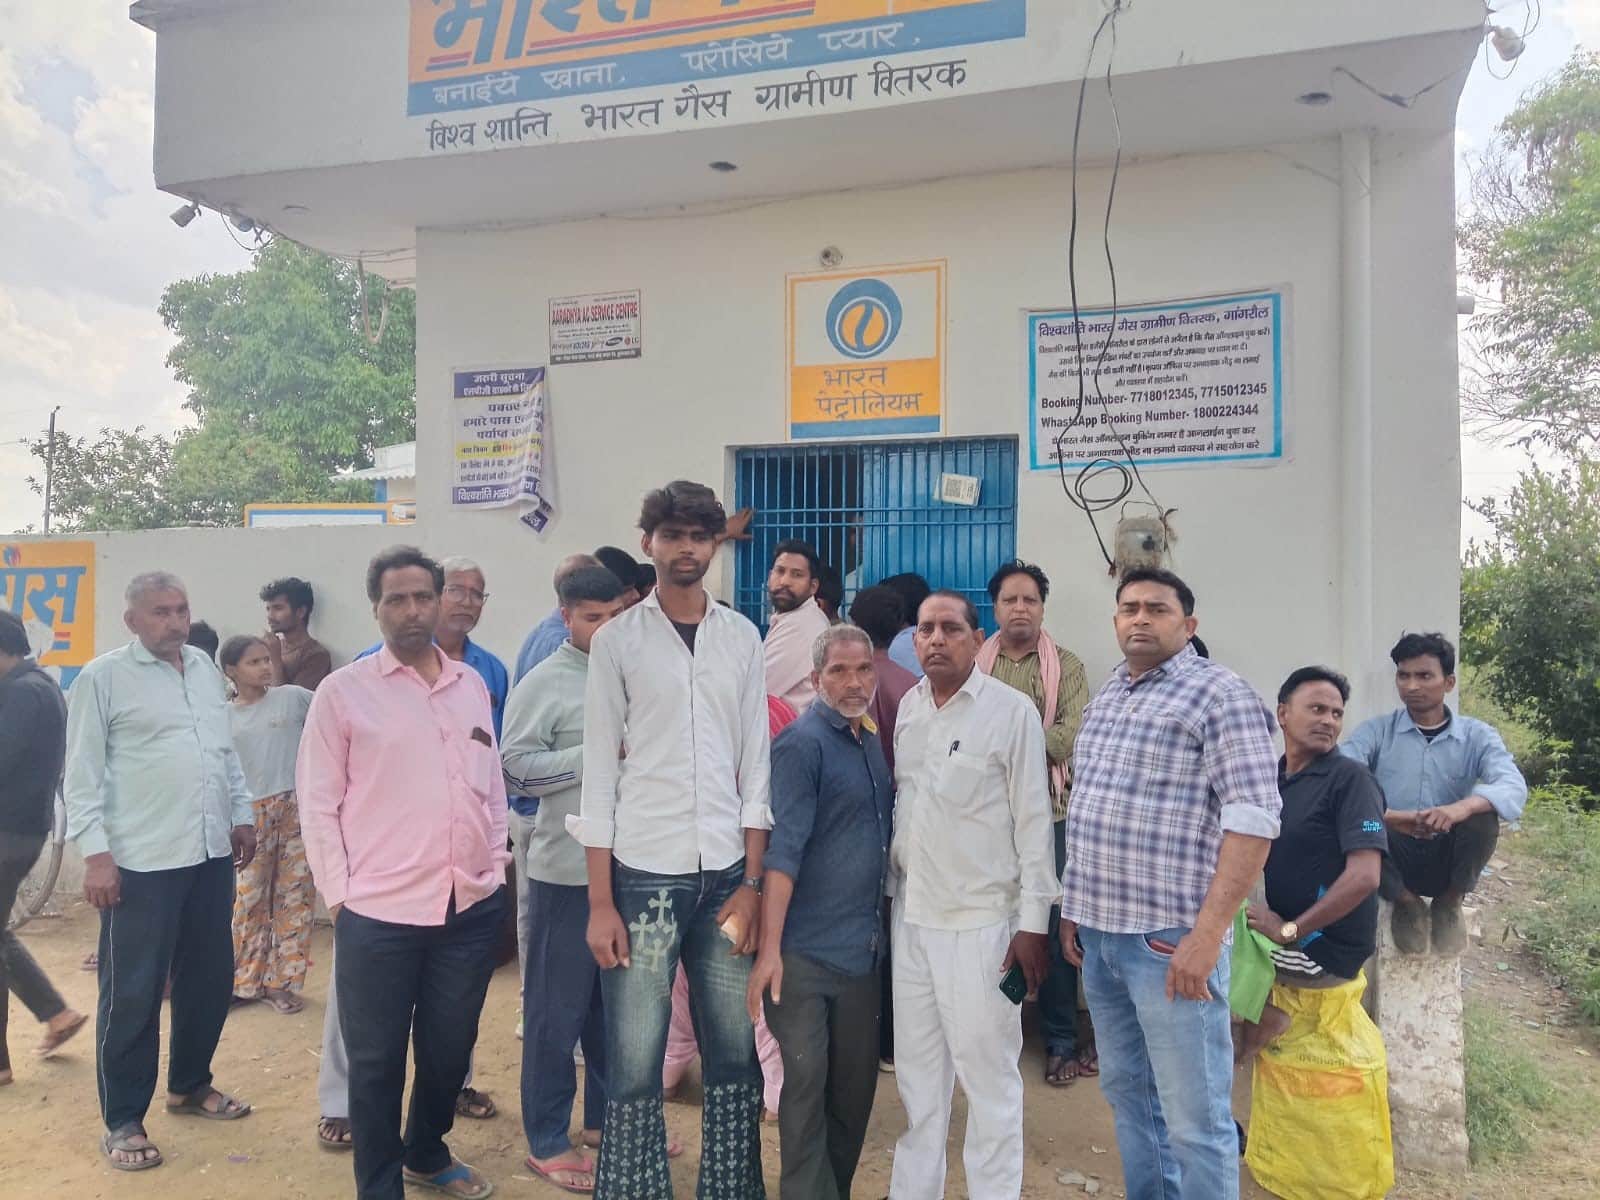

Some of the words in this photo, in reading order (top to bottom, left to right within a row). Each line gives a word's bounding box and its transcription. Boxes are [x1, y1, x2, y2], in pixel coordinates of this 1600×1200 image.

[425, 119, 476, 150] विश्व
[484, 107, 552, 143] शान्ति
[581, 99, 664, 131] भारत
[674, 84, 732, 120] गैस
[755, 70, 857, 112] ग्रामीण
[868, 60, 967, 97] वितरक
[591, 303, 614, 321] SERVICE
[616, 301, 638, 319] CENTRE
[1140, 314, 1177, 331] ग्रामीण
[823, 366, 888, 387] भारत
[1041, 396, 1080, 409] Booking
[1130, 387, 1198, 403] 7718012345,
[1200, 382, 1267, 398] 7715012345
[1101, 411, 1142, 425] Booking
[1193, 403, 1259, 418] 1800224344
